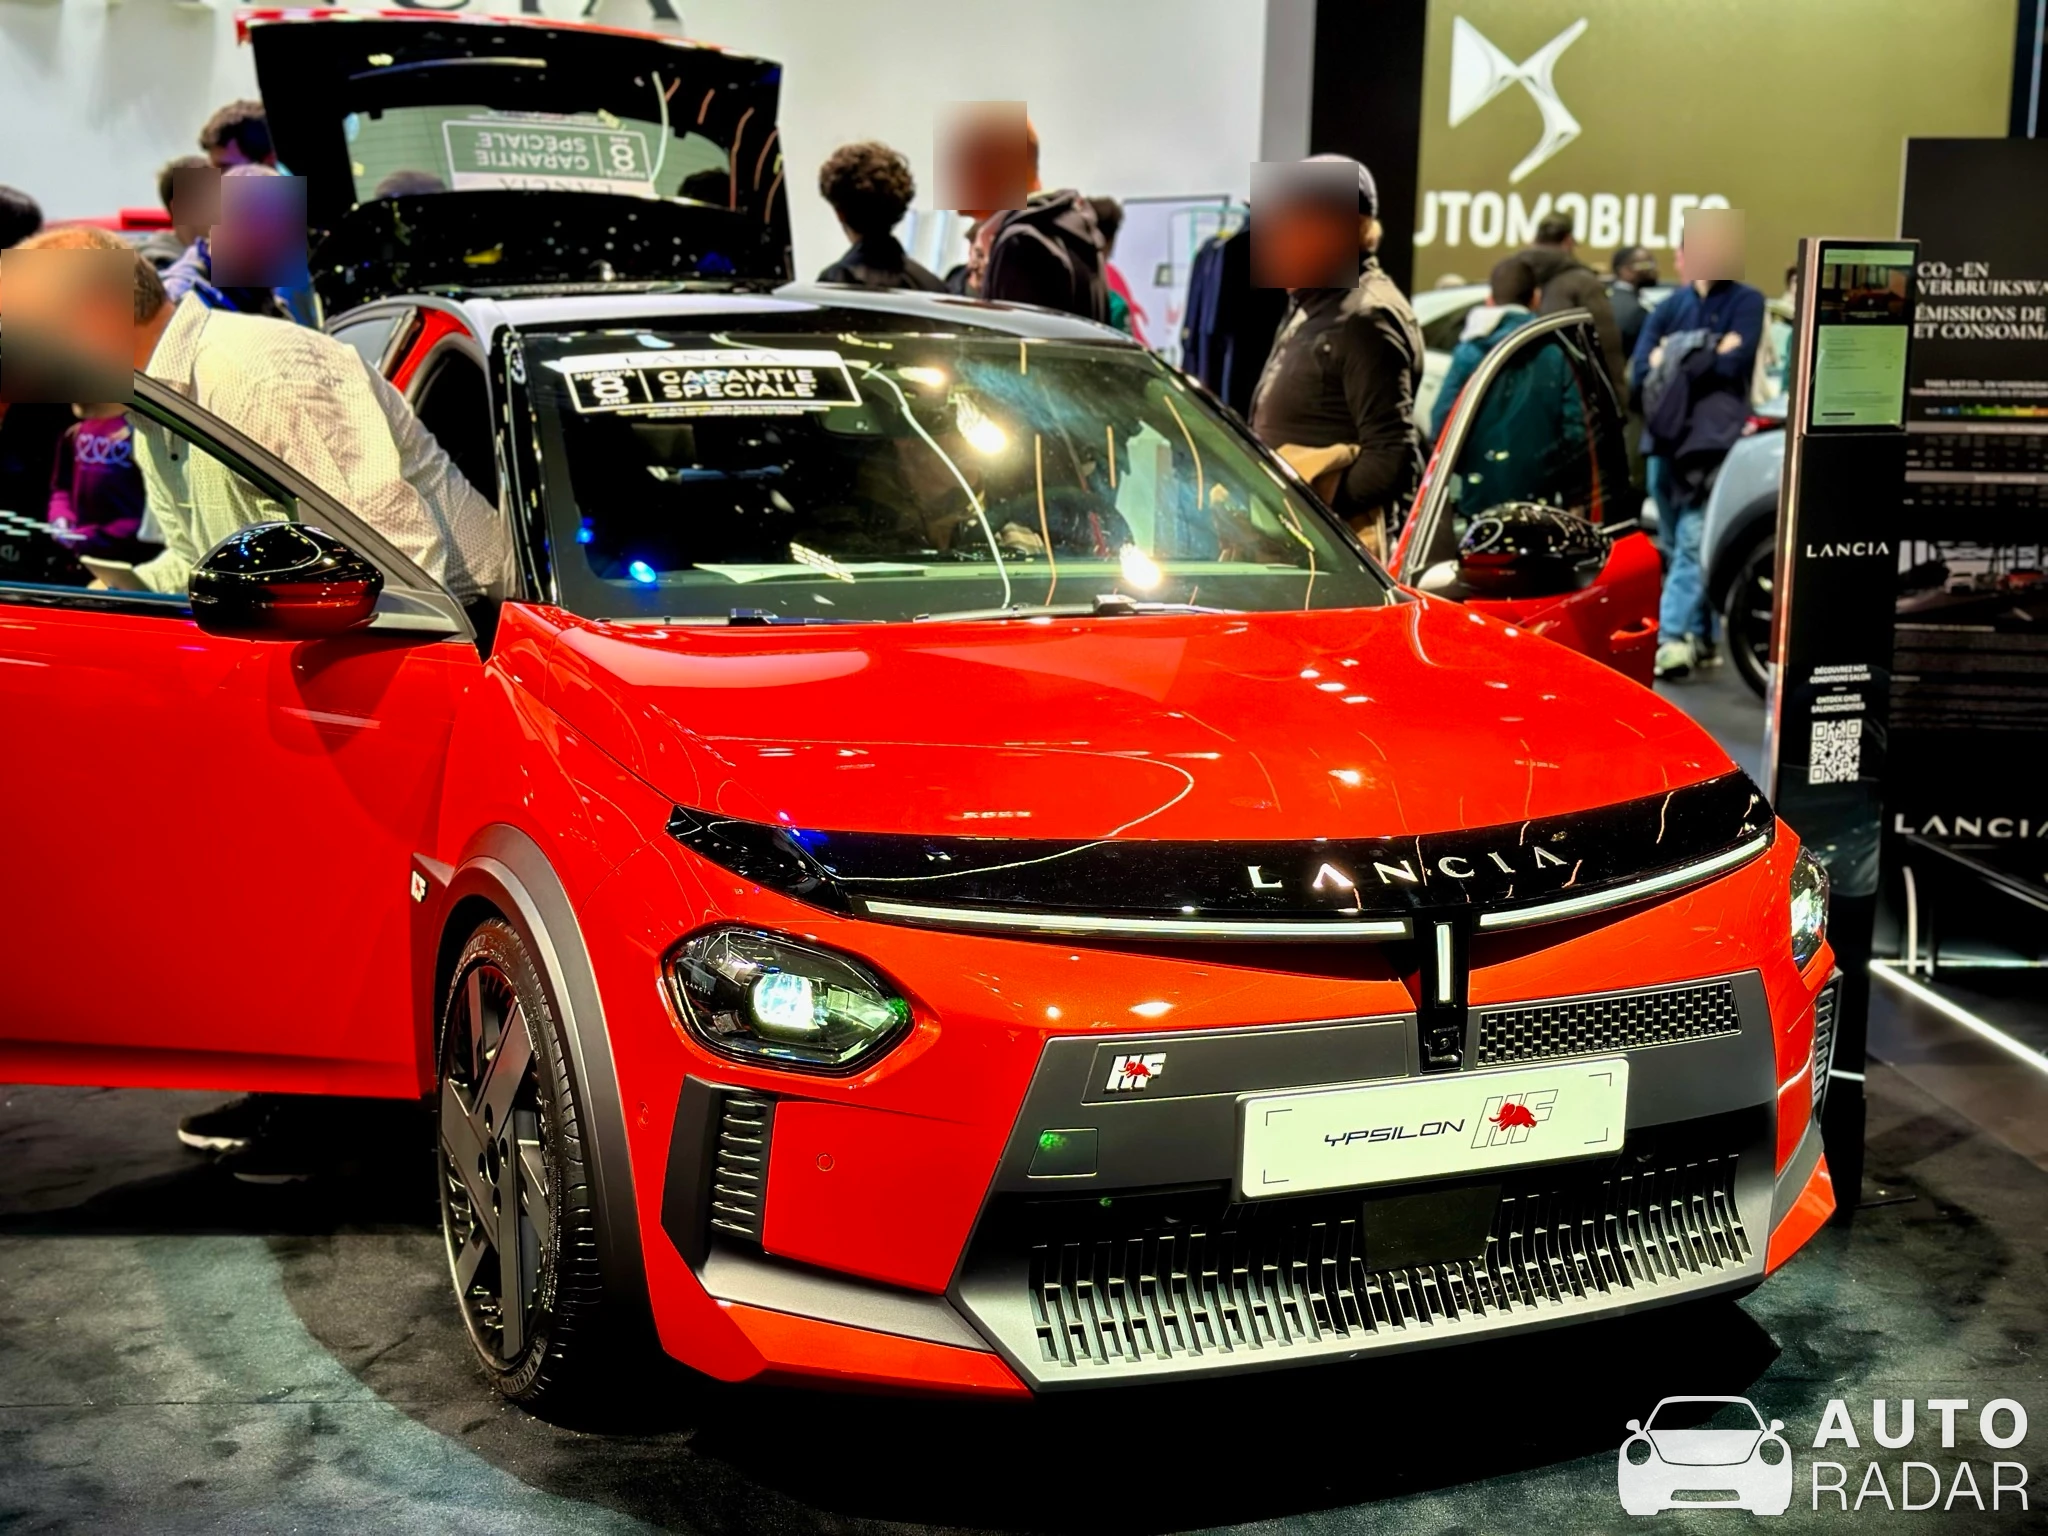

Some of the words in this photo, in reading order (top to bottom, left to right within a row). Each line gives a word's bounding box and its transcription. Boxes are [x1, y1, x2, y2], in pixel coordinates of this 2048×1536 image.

[475, 150, 590, 171] GARANTIE
[610, 144, 635, 171] 8
[1915, 302, 2017, 322] ÉMISSIONS
[2021, 306, 2046, 322] DE
[1913, 323, 1938, 339] ET
[1941, 323, 2048, 339] CONSOMM
[657, 368, 817, 384] GARANTIE
[591, 376, 629, 399] 8
[1806, 541, 1889, 558] LANCIA
[1247, 846, 1567, 888] LANCIA
[685, 980, 711, 996] LANCIA
[1324, 1119, 1465, 1147] YPSILON
